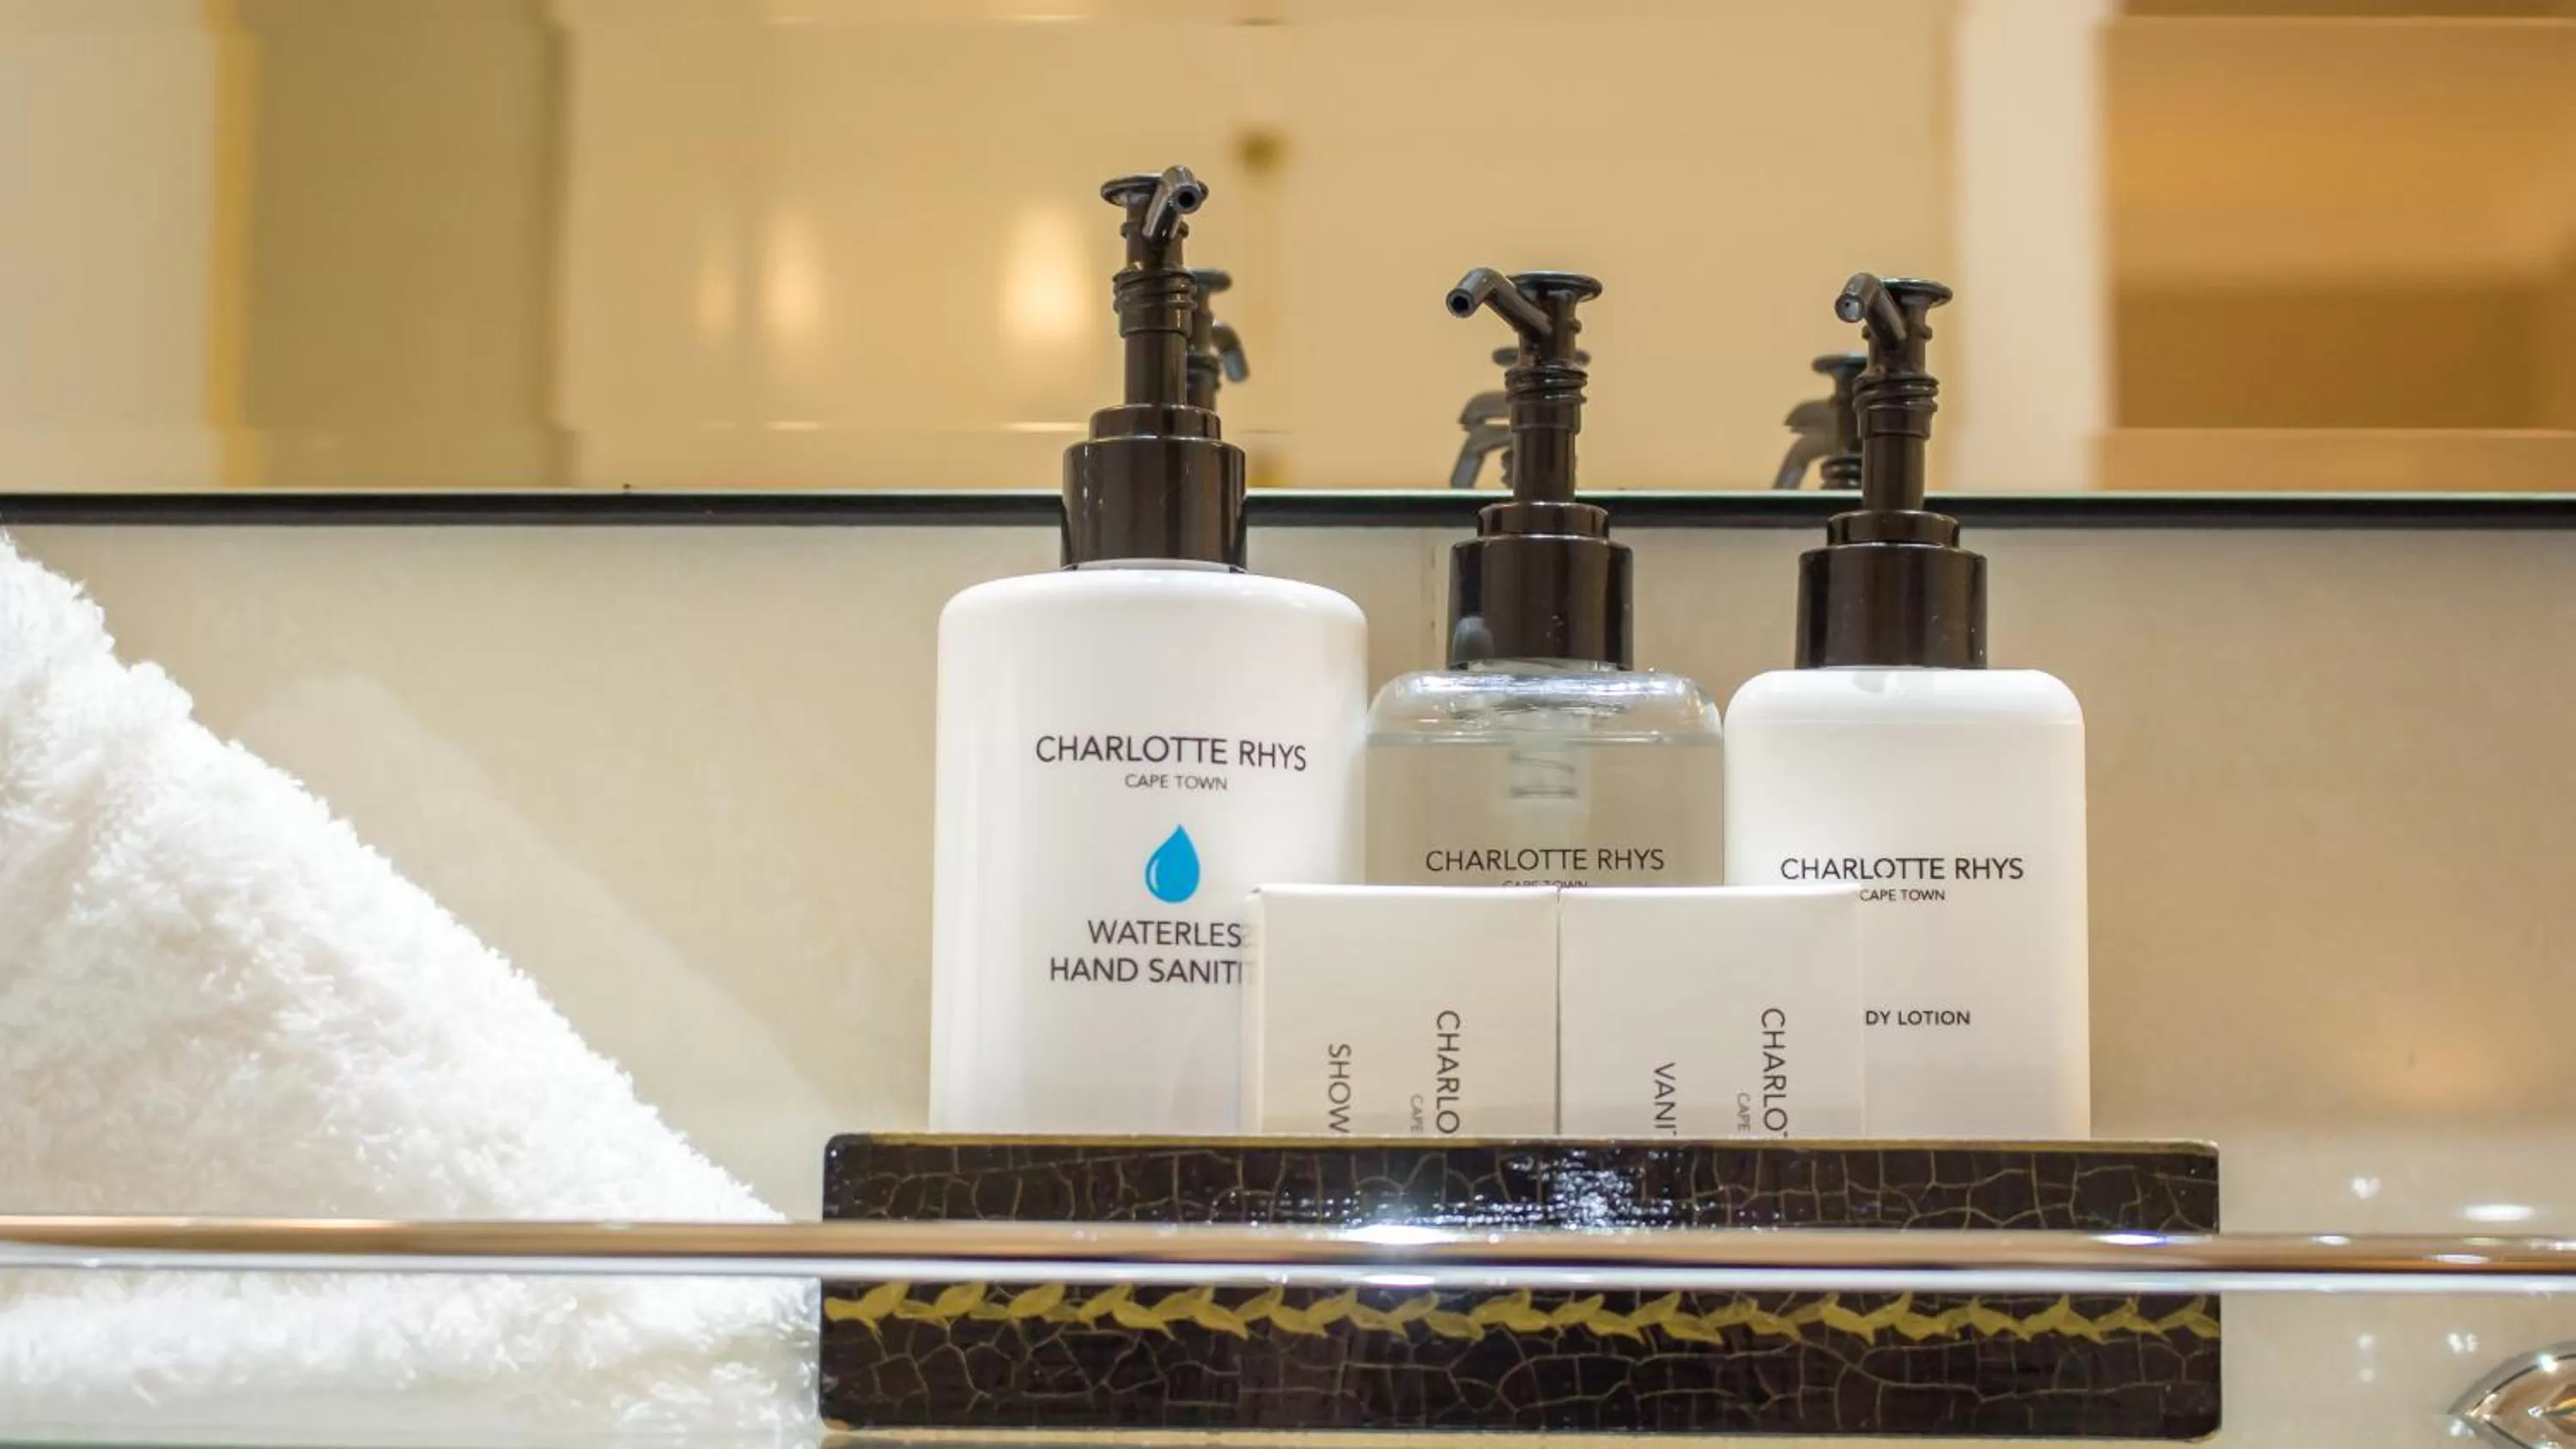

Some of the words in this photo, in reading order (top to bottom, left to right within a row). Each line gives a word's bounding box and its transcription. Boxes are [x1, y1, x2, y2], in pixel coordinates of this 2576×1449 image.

[1036, 735, 1228, 765] CHARLOTTE
[1239, 740, 1307, 772] RHYS
[1124, 773, 1169, 789] CAPE
[1174, 774, 1228, 791] TOWN
[1425, 848, 1588, 871] CHARLOTTE
[1597, 848, 1666, 870] RHYS
[1780, 858, 1945, 880] CHARLOTTE
[1954, 858, 2025, 880] RHYS
[1859, 888, 1897, 901] CAPE
[1899, 888, 1946, 901] TOWN
[1050, 957, 1139, 983] HAND
[1898, 1009, 1971, 1026] LOTION
[1436, 1009, 1461, 1134] CHARLO
[1328, 1043, 1352, 1133] SHOW
[1410, 1094, 1424, 1133] CAPE
[1737, 1092, 1751, 1132] CAPE
